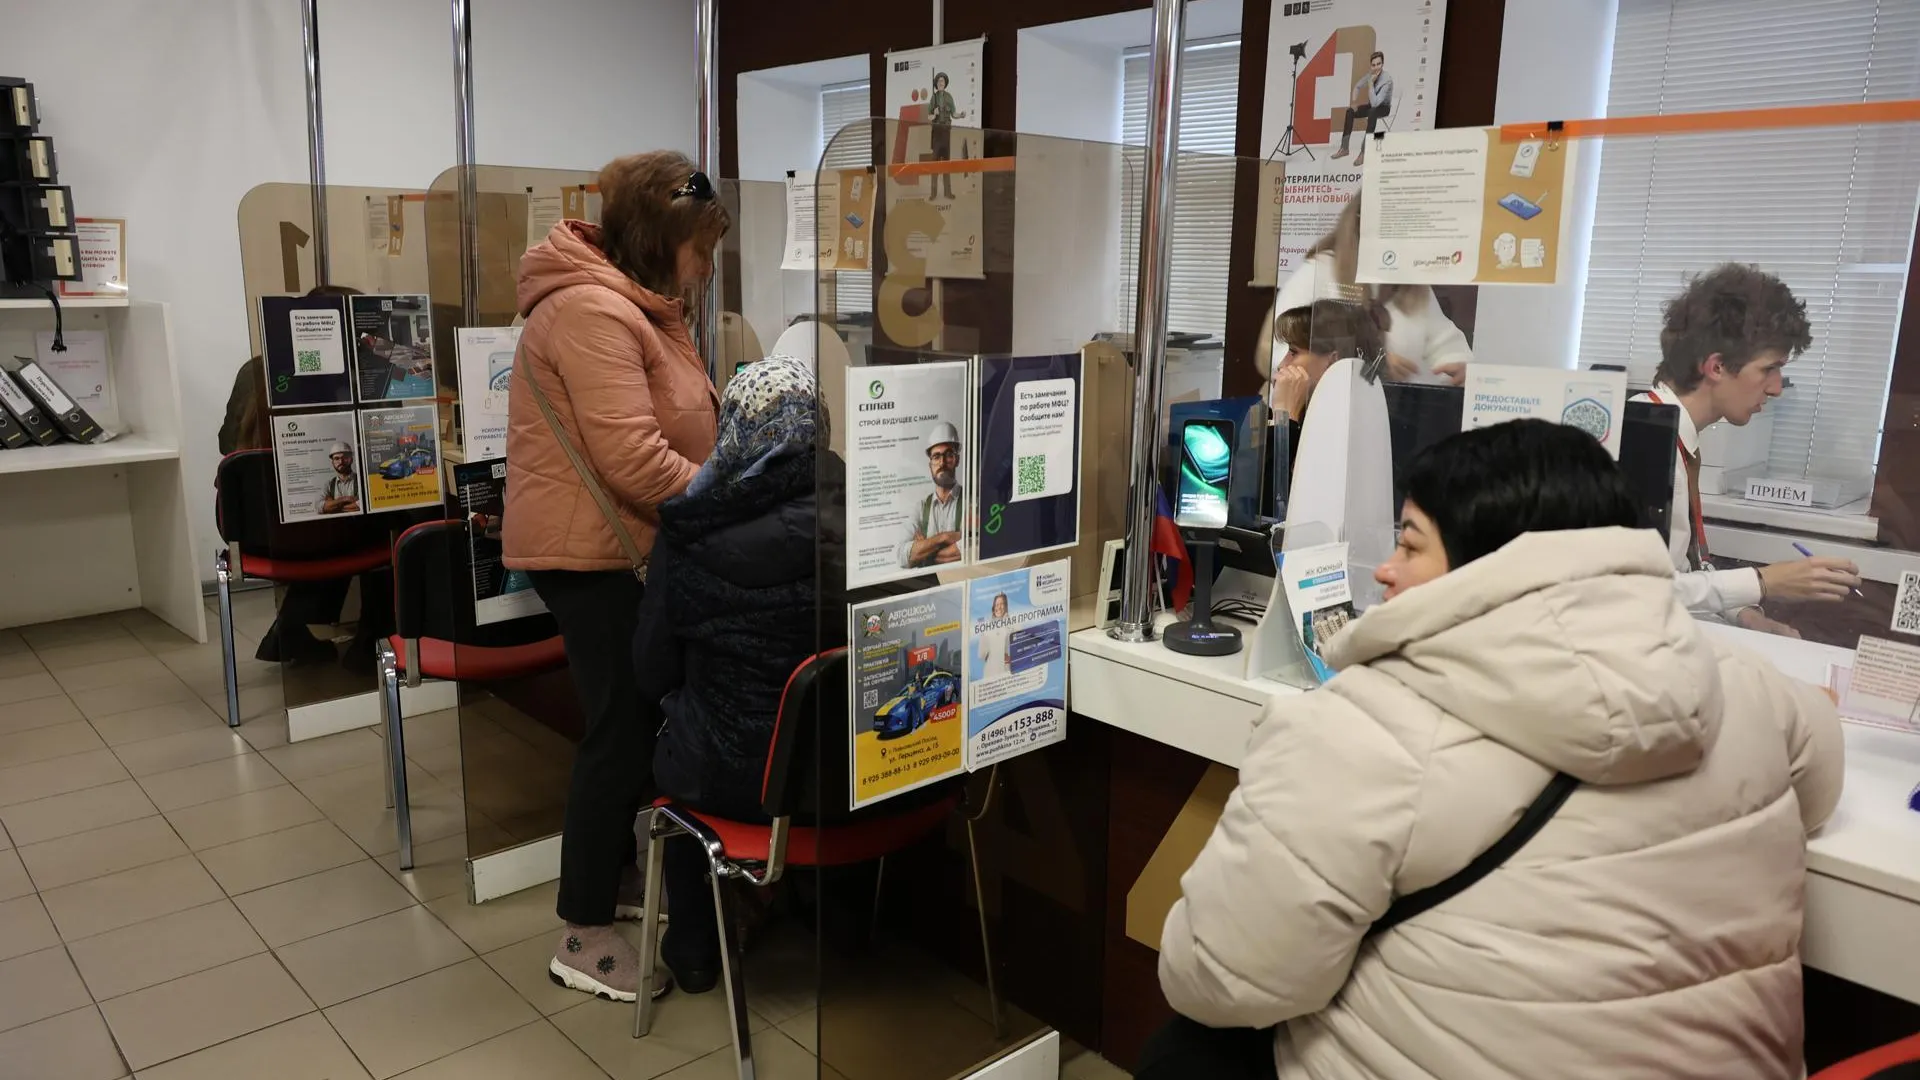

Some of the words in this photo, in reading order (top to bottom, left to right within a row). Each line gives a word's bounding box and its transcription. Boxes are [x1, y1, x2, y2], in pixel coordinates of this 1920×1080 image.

[1275, 175, 1320, 185] ПОТЕРЯЛИ
[1323, 174, 1362, 183] ПАСПОР
[1020, 392, 1034, 400] Есть
[1035, 390, 1067, 398] замечания
[1475, 394, 1540, 405] ПРЕДОСТАВЬТЕ
[1029, 401, 1051, 411] работе
[1051, 399, 1069, 407] МФЦ?
[1473, 404, 1531, 413] ДОКУМЕНТЫ
[859, 419, 881, 427] СТРОЙ
[882, 416, 913, 426] БУДУЩЕЕ
[1020, 413, 1050, 422] Сообщите
[1051, 411, 1065, 419] нам!
[1751, 484, 1807, 502] ПРИЁМ
[974, 615, 1017, 634] БОНУСНАЯ
[1017, 604, 1064, 623] ПРОГРАММА
[981, 733, 986, 741] 8
[987, 726, 1007, 739] (496)
